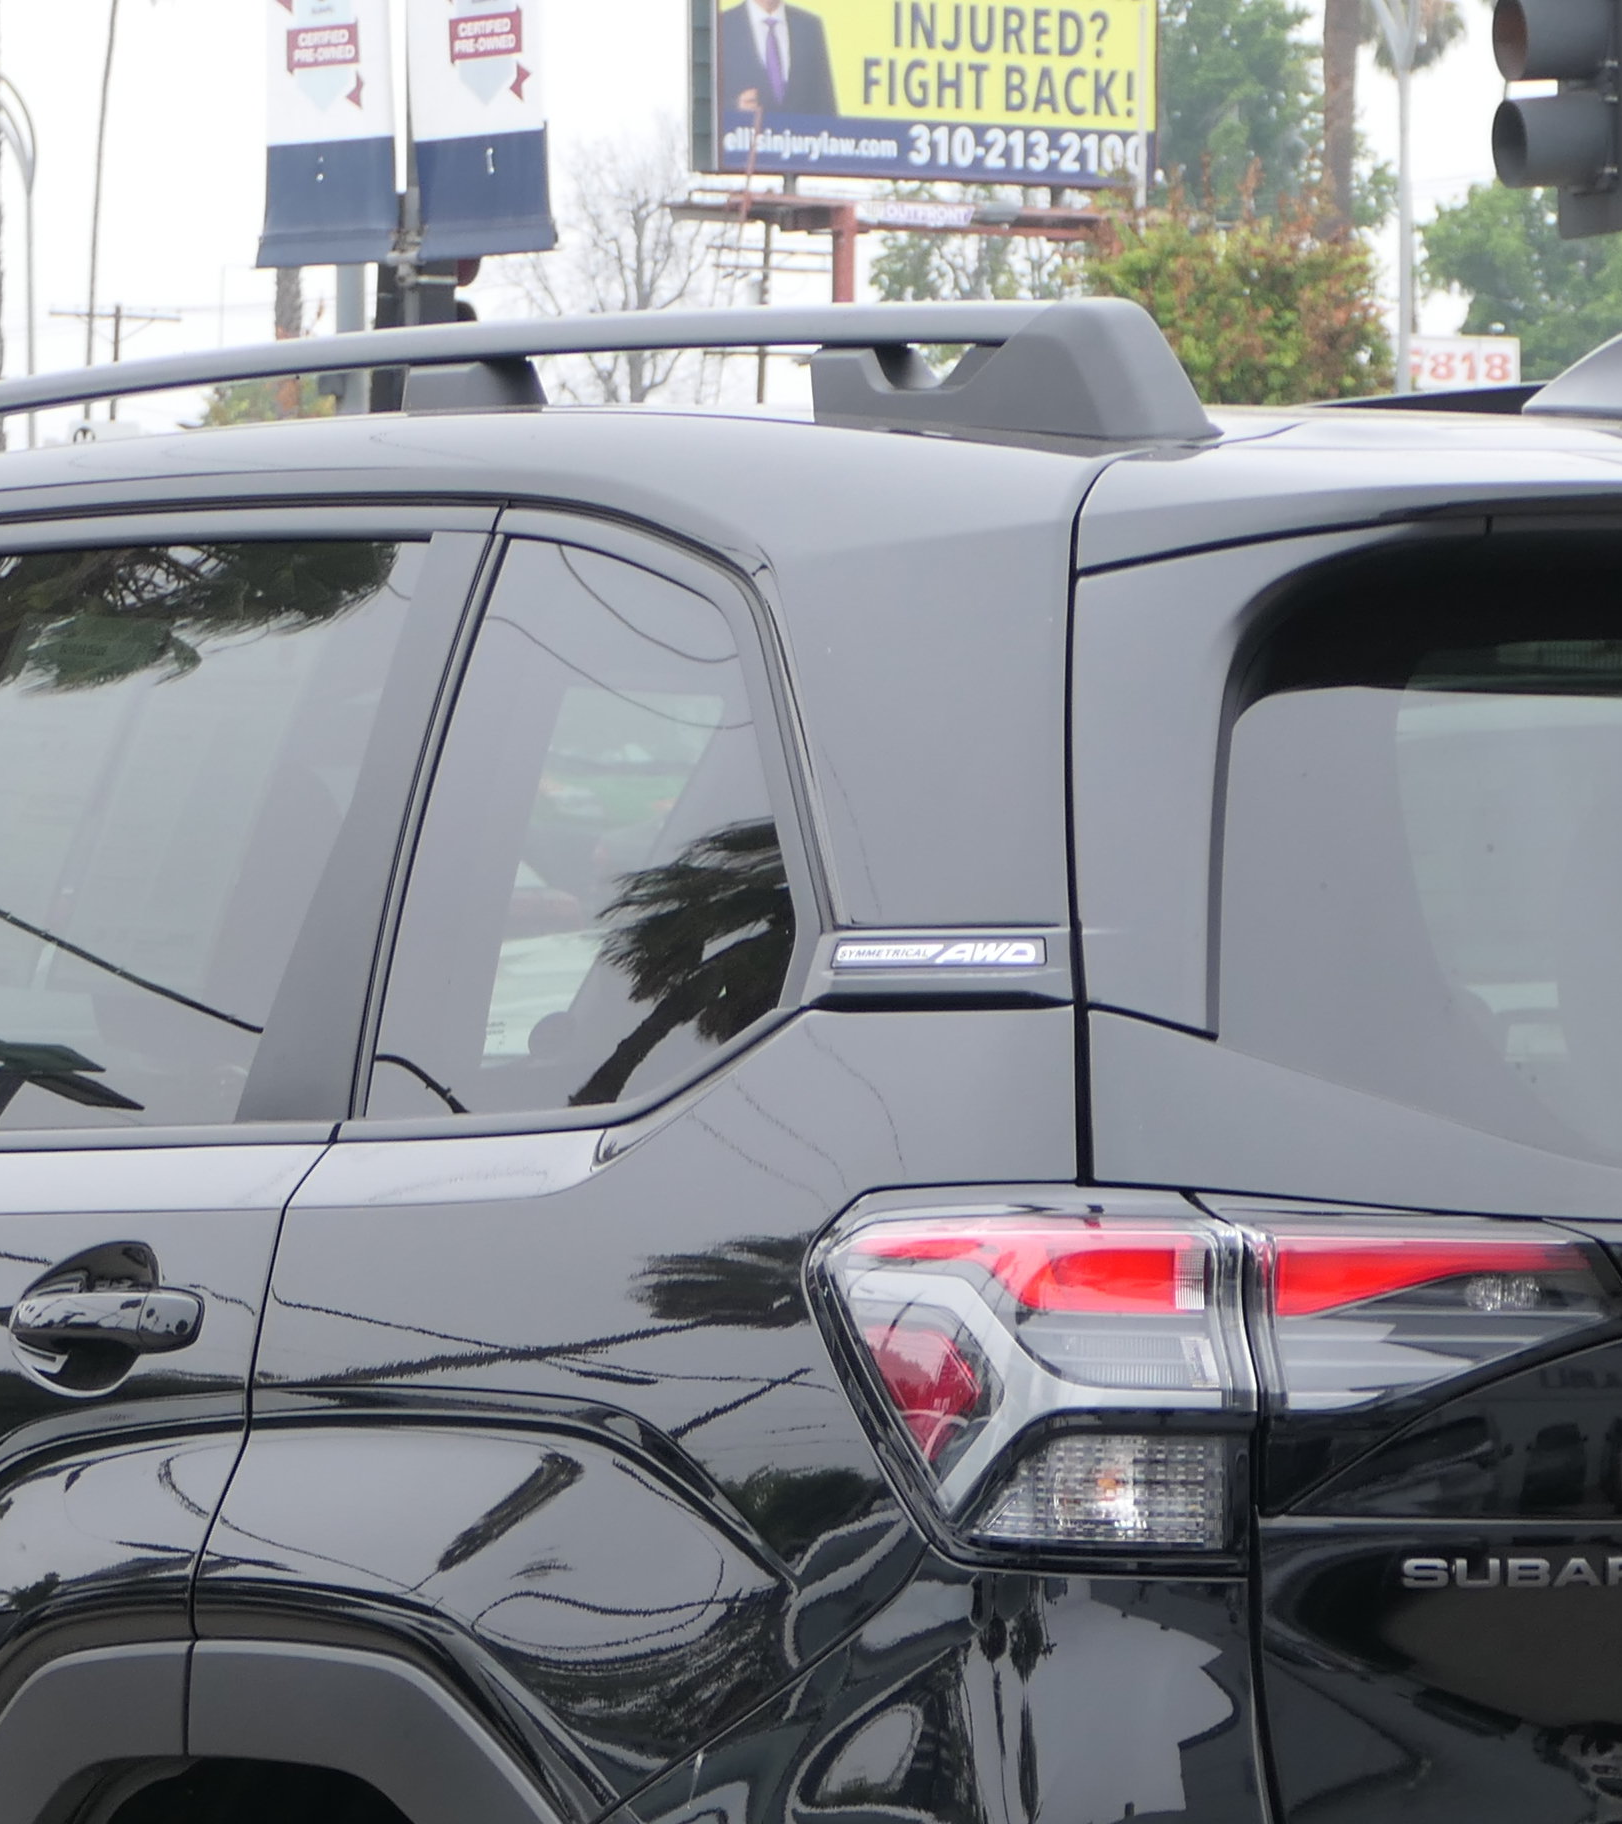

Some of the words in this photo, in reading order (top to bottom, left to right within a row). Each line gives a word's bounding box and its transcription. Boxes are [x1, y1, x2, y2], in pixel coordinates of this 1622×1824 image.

[457, 17, 511, 38] CERTIFIED
[892, 1, 1110, 59] INJURED?
[863, 57, 991, 111] FIGHT
[1004, 64, 1136, 119] BACK!
[908, 124, 1144, 175] 310-213-2100
[838, 947, 929, 961] SYMMETRICAL
[934, 942, 1037, 964] AWD
